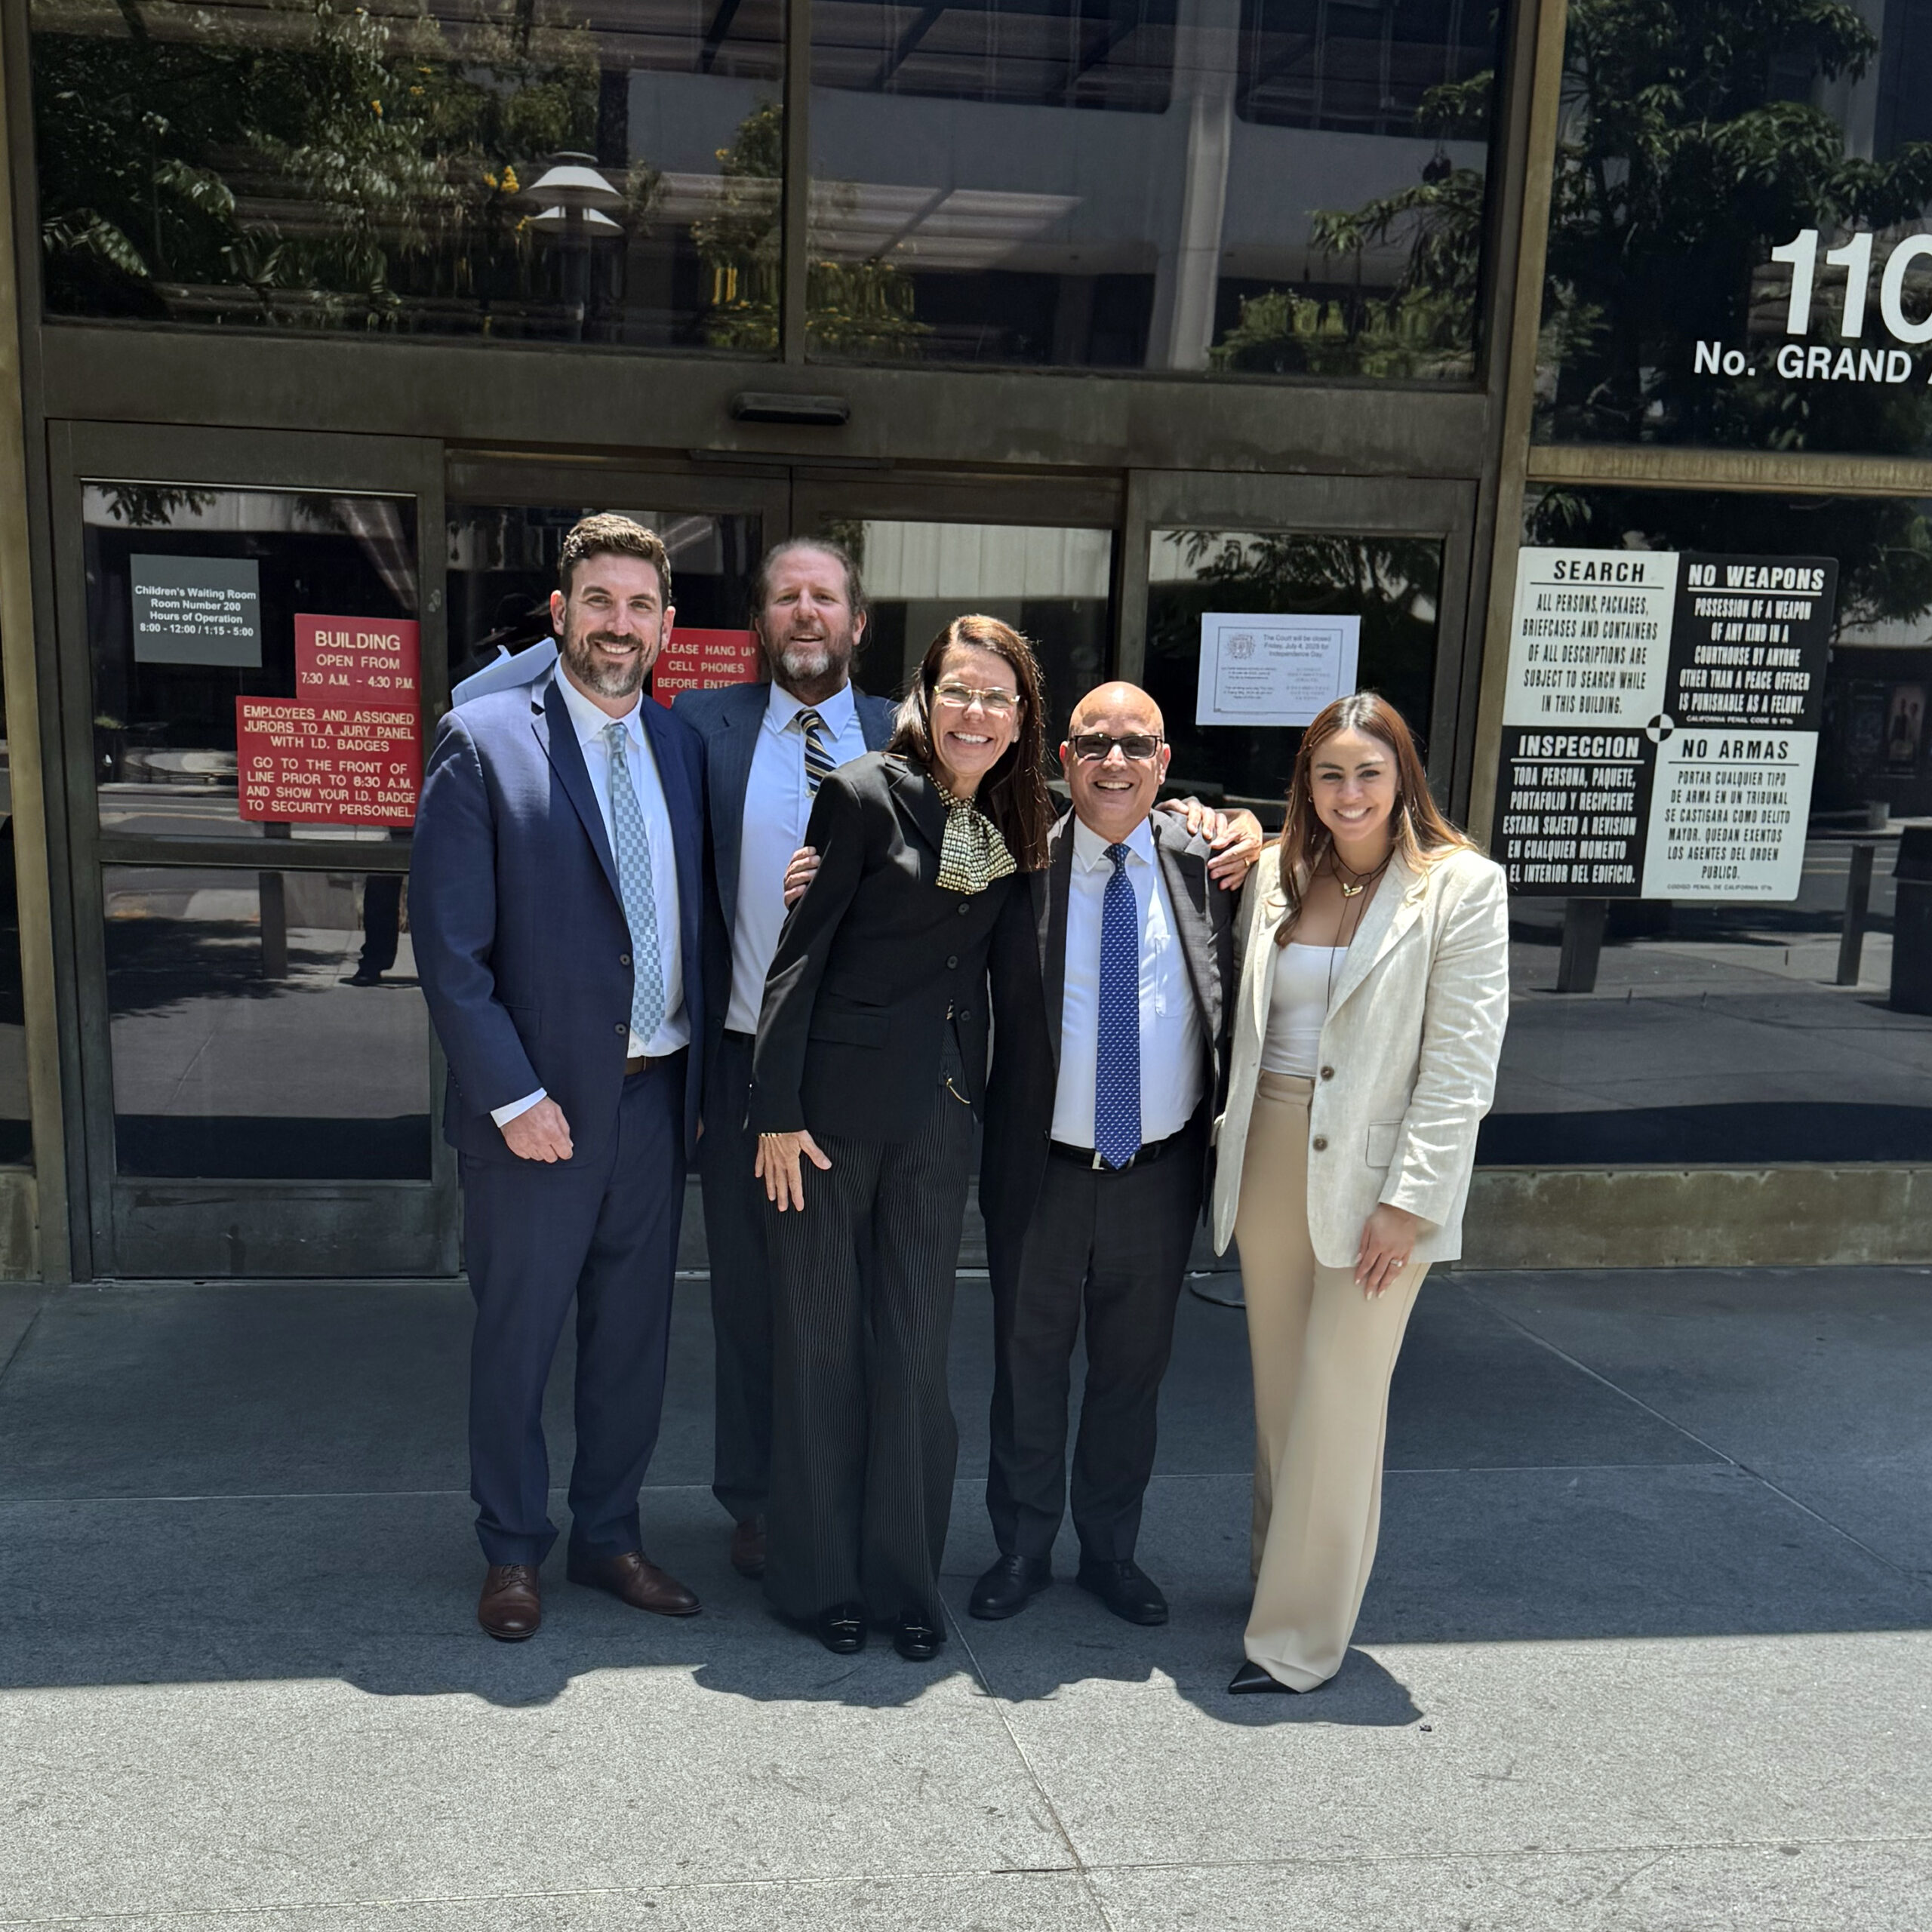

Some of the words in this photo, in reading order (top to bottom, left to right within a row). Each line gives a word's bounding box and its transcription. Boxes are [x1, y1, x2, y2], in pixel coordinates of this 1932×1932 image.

[1771, 229, 1932, 343] 110
[1694, 340, 1755, 376] No.
[1777, 344, 1912, 383] GRAND
[1553, 560, 1644, 582] SEARCH
[1688, 565, 1716, 586] NO
[1727, 566, 1825, 590] WEAPONS
[135, 586, 185, 596] Children's
[187, 588, 224, 600] Waiting
[227, 589, 256, 599] Room
[151, 598, 180, 608] Room
[183, 600, 220, 610] Number
[224, 602, 241, 611] 200
[1537, 594, 1551, 611] ALL
[1556, 594, 1598, 614] PERSONS,
[1600, 596, 1648, 616] PACKAGES,
[1694, 598, 1749, 618] POSSESSION
[1751, 599, 1764, 618] OF
[1765, 600, 1772, 619] A
[1775, 601, 1811, 620] WEAPON
[150, 611, 180, 620] Hours
[183, 613, 192, 621] of
[195, 613, 242, 623] Operation
[140, 623, 160, 632] 8:00
[170, 624, 195, 633] 12:00
[205, 626, 224, 635] 1:15
[233, 627, 254, 636] 5:00
[1522, 618, 1577, 637] BRIEFCASES
[1580, 620, 1598, 638] AND
[1603, 621, 1658, 640] CONTAINERS
[1711, 622, 1723, 641] OF
[1724, 623, 1743, 641] ANY
[1745, 623, 1767, 641] KIND
[1769, 624, 1780, 642] IN
[1782, 625, 1789, 643] A
[315, 631, 401, 651] BUILDING
[661, 644, 699, 654] LEASE
[705, 645, 735, 656] HANG
[741, 647, 755, 657] UP
[316, 654, 353, 666] OPEN
[361, 657, 400, 669] FROM
[1528, 645, 1539, 661] OF
[1543, 645, 1557, 662] ALL
[1562, 645, 1626, 664] DESCRIPTIONS
[1629, 647, 1647, 665] ARE
[1694, 645, 1750, 666] COURTHOUSE
[1766, 648, 1801, 667] ANYONE
[669, 660, 694, 672] CELL
[701, 663, 745, 673] PHONES
[302, 672, 323, 685] 7:30
[329, 674, 350, 686] A.M.
[368, 676, 390, 688] 4:30
[395, 677, 414, 689] P.M.
[657, 678, 698, 688] BEFORE
[1524, 669, 1563, 688] SUBJECT
[1567, 670, 1577, 688] TO
[1580, 671, 1616, 689] SEARCH
[1620, 672, 1646, 689] WHILE
[1680, 669, 1707, 688] OTHER
[1710, 669, 1733, 688] THAN
[1735, 670, 1742, 689] A
[1744, 671, 1772, 690] PEACE
[1774, 672, 1810, 691] OFFICER
[1542, 695, 1552, 712] IN
[1555, 695, 1575, 712] THIS
[1579, 696, 1622, 714] BUILDING.
[1678, 693, 1689, 711] IS
[1691, 693, 1744, 712] PUNISHABLE
[1746, 694, 1759, 713] AS
[1761, 695, 1768, 713] A
[1771, 695, 1804, 714] FELONY.
[244, 705, 315, 719] EMPLOYEES
[322, 709, 347, 721] AND
[354, 712, 414, 725] ASSIGNED
[245, 721, 294, 733] JURORS
[302, 722, 318, 734] TO
[325, 724, 334, 735] A
[340, 725, 370, 737] JURY
[377, 727, 414, 740] PANEL
[270, 736, 304, 748] WITH
[311, 738, 330, 749] I.D.
[337, 740, 389, 752] BADGES
[1518, 735, 1639, 758] INSPECCION
[1682, 740, 1708, 758] NO
[1718, 740, 1789, 759] ARMAS
[253, 756, 273, 768] GO
[281, 758, 299, 769] TO
[306, 759, 332, 771] THE
[339, 761, 383, 773] FRONT
[390, 764, 407, 774] OF
[247, 771, 275, 783] LINE
[282, 773, 321, 785] PRIOR
[329, 774, 346, 786] TO
[353, 776, 380, 788] 8:30
[387, 778, 414, 789] A.M.
[1514, 767, 1537, 786] TODA
[1542, 767, 1588, 789] PERSONA,
[1592, 768, 1635, 790] PAQUETE,
[1678, 771, 1711, 785] PORTAR
[1715, 771, 1763, 788] CUALQUIER
[1767, 772, 1786, 786] TIPO
[247, 786, 270, 797] AND
[276, 787, 312, 798] SHOW
[318, 789, 349, 800] YOUR
[355, 790, 371, 801] I.D.
[377, 792, 415, 803] BADGE
[1510, 791, 1567, 811] PORTAFOLIO
[1571, 792, 1577, 811] Y
[1580, 792, 1635, 811] RECIPIENTE
[1671, 789, 1681, 803] DE
[1685, 790, 1710, 804] ARMA
[1715, 790, 1726, 804] EN
[1730, 791, 1742, 804] UN
[1747, 791, 1788, 804] TRIBUNAL
[248, 799, 263, 811] TO
[271, 801, 332, 814] SECURITY
[340, 804, 416, 818] PERSONNEL.
[1665, 808, 1676, 822] SE
[1680, 809, 1728, 823] CASTIGARA
[1732, 810, 1757, 823] COMO
[1761, 810, 1790, 824] DELITO
[1503, 815, 1539, 835] ESTARA
[1543, 816, 1579, 835] SUJETO
[1581, 816, 1588, 835] A
[1592, 817, 1637, 835] REVISION
[1668, 828, 1700, 841] MAYOR.
[1705, 829, 1740, 844] QUEDAN
[1744, 829, 1783, 842] EXENTOS
[1508, 840, 1521, 858] EN
[1524, 840, 1577, 862] CUALQUIER
[1580, 841, 1626, 860] MOMENTO
[1668, 847, 1684, 860] LOS
[1687, 847, 1726, 860] AGENTES
[1730, 848, 1746, 860] DEL
[1749, 848, 1779, 861] ORDEN
[1509, 864, 1521, 882] EL
[1524, 864, 1568, 883] INTERIOR
[1571, 865, 1589, 883] DEL
[1592, 865, 1635, 883] EDIFICIO.
[1701, 866, 1740, 879] PUBLICO.
